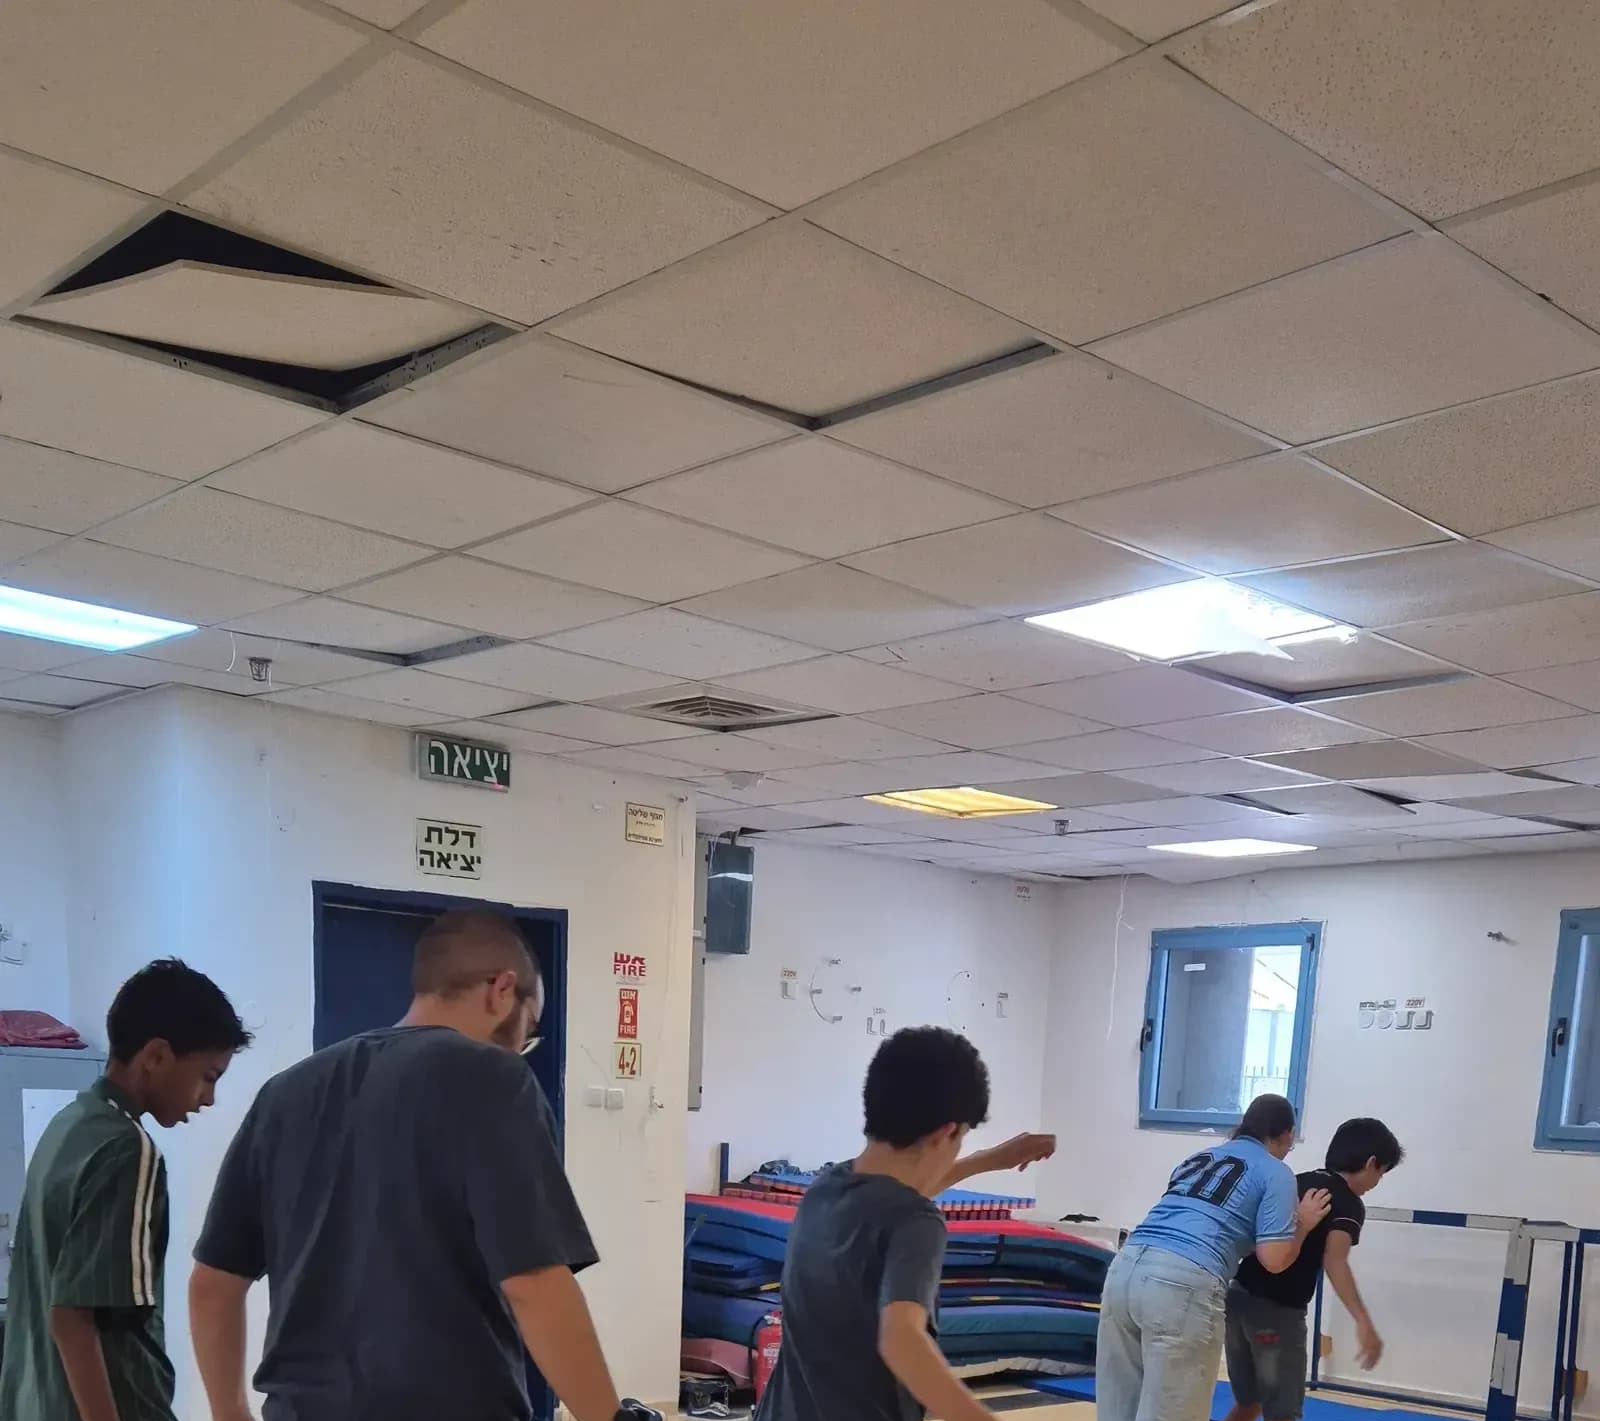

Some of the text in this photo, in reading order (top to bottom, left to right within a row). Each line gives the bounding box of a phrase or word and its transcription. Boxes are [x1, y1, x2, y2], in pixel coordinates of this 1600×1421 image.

[430, 740, 508, 784] יציאה
[424, 825, 476, 848] דלת
[419, 849, 482, 872] יציאה
[613, 951, 646, 965] אש
[613, 963, 647, 977] FIRE
[621, 990, 637, 1000] אש
[620, 1024, 637, 1034] FIRE
